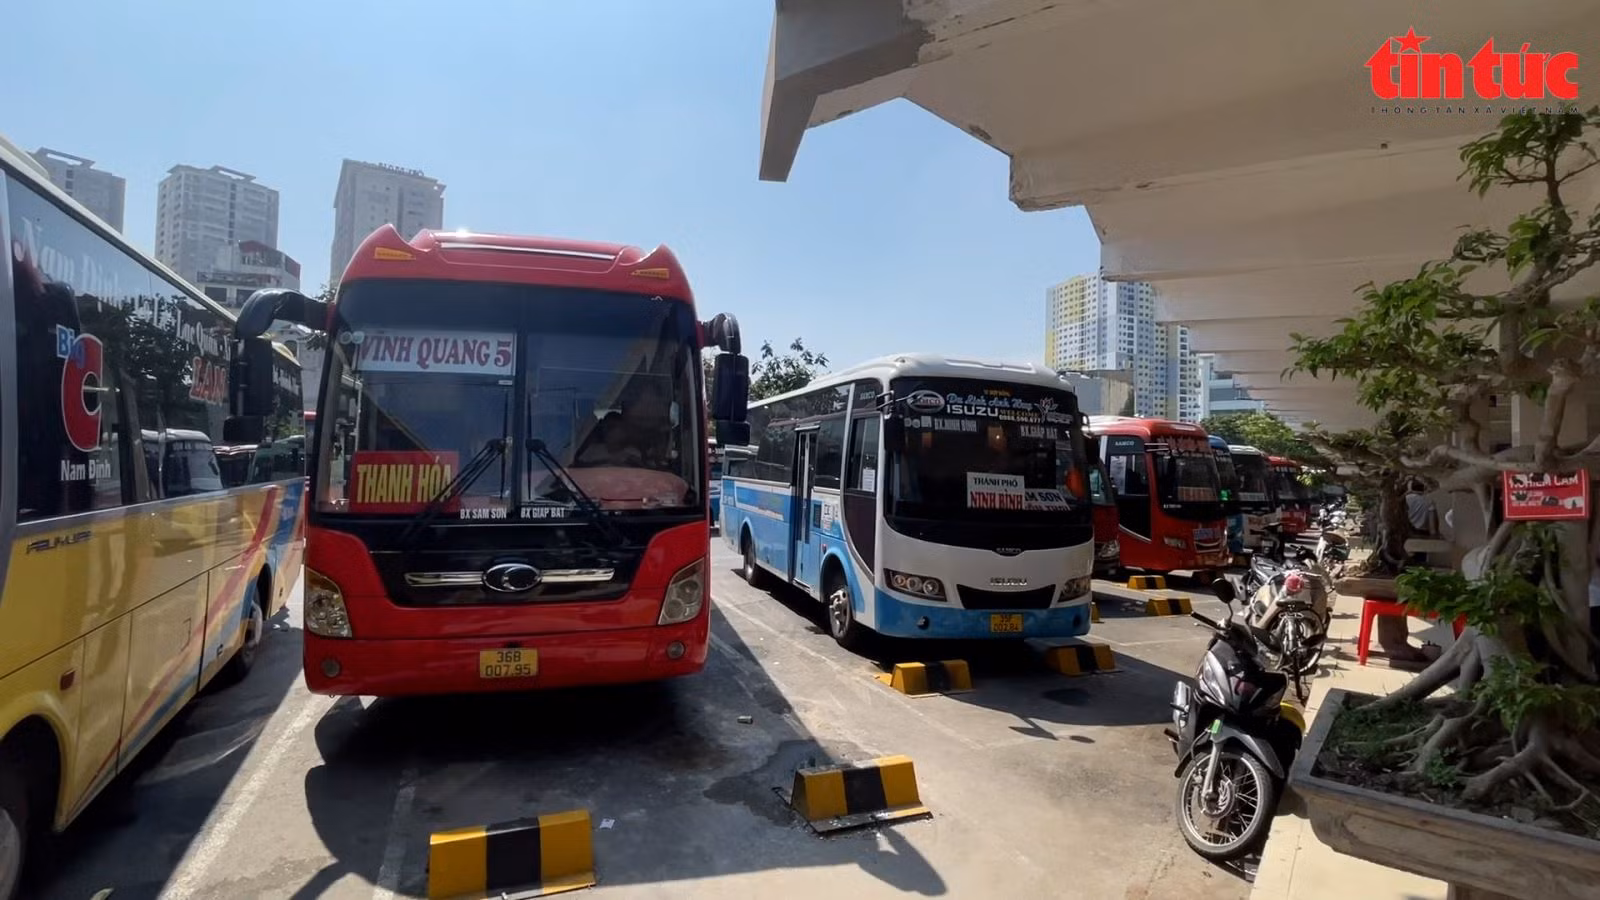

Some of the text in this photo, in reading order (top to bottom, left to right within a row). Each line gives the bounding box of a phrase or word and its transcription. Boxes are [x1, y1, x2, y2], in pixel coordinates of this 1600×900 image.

[417, 337, 490, 369] QUANG
[494, 339, 512, 367] 5
[946, 404, 1000, 418] ISUZU
[60, 459, 86, 481] Nam
[356, 456, 452, 504] THANH HÓA
[970, 490, 996, 509] NINH
[998, 489, 1023, 509] BÌNH
[472, 508, 489, 519] SAM
[497, 651, 521, 662] 36B
[486, 664, 531, 676] 007.95
